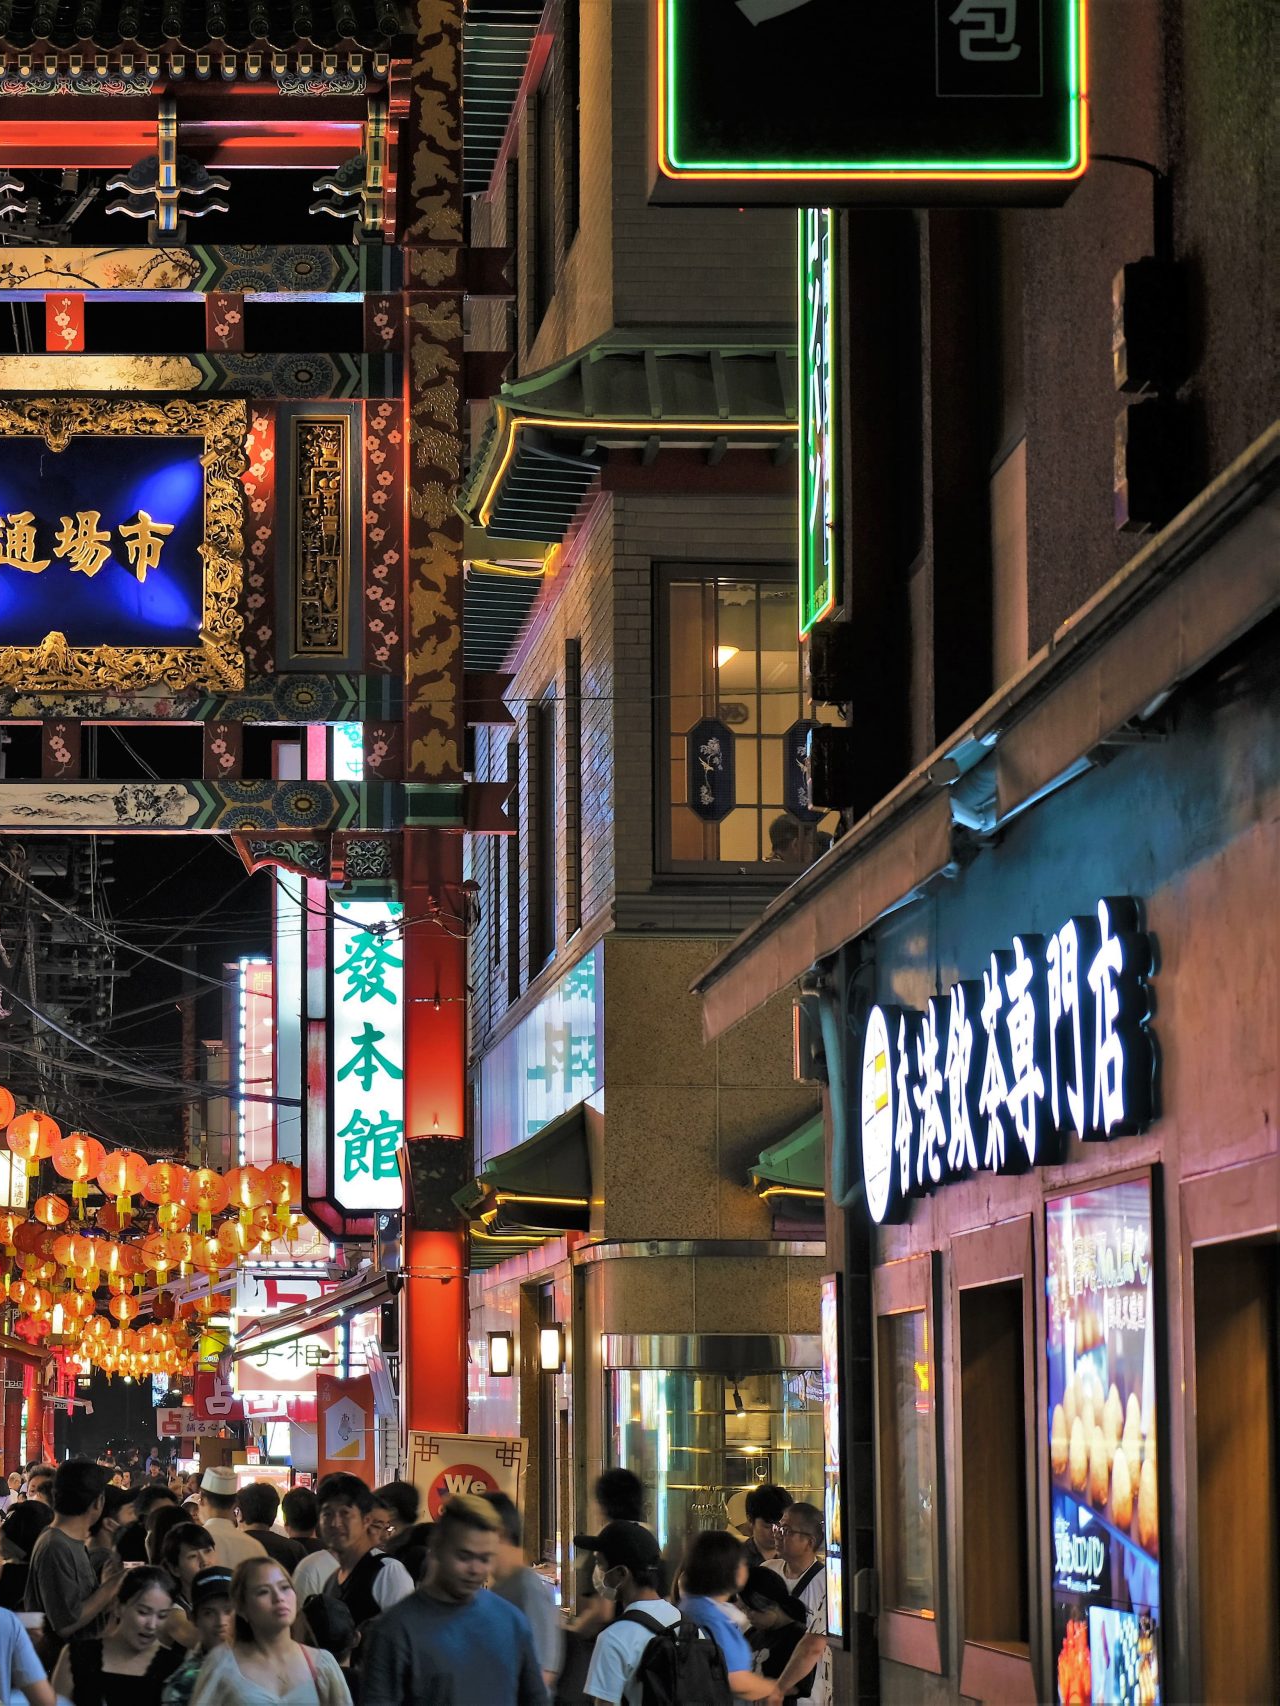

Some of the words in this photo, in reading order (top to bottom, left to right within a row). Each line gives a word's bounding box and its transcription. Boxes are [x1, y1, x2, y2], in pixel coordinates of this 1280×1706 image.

[334, 902, 405, 1182] 發本館
[444, 1473, 487, 1494] We
